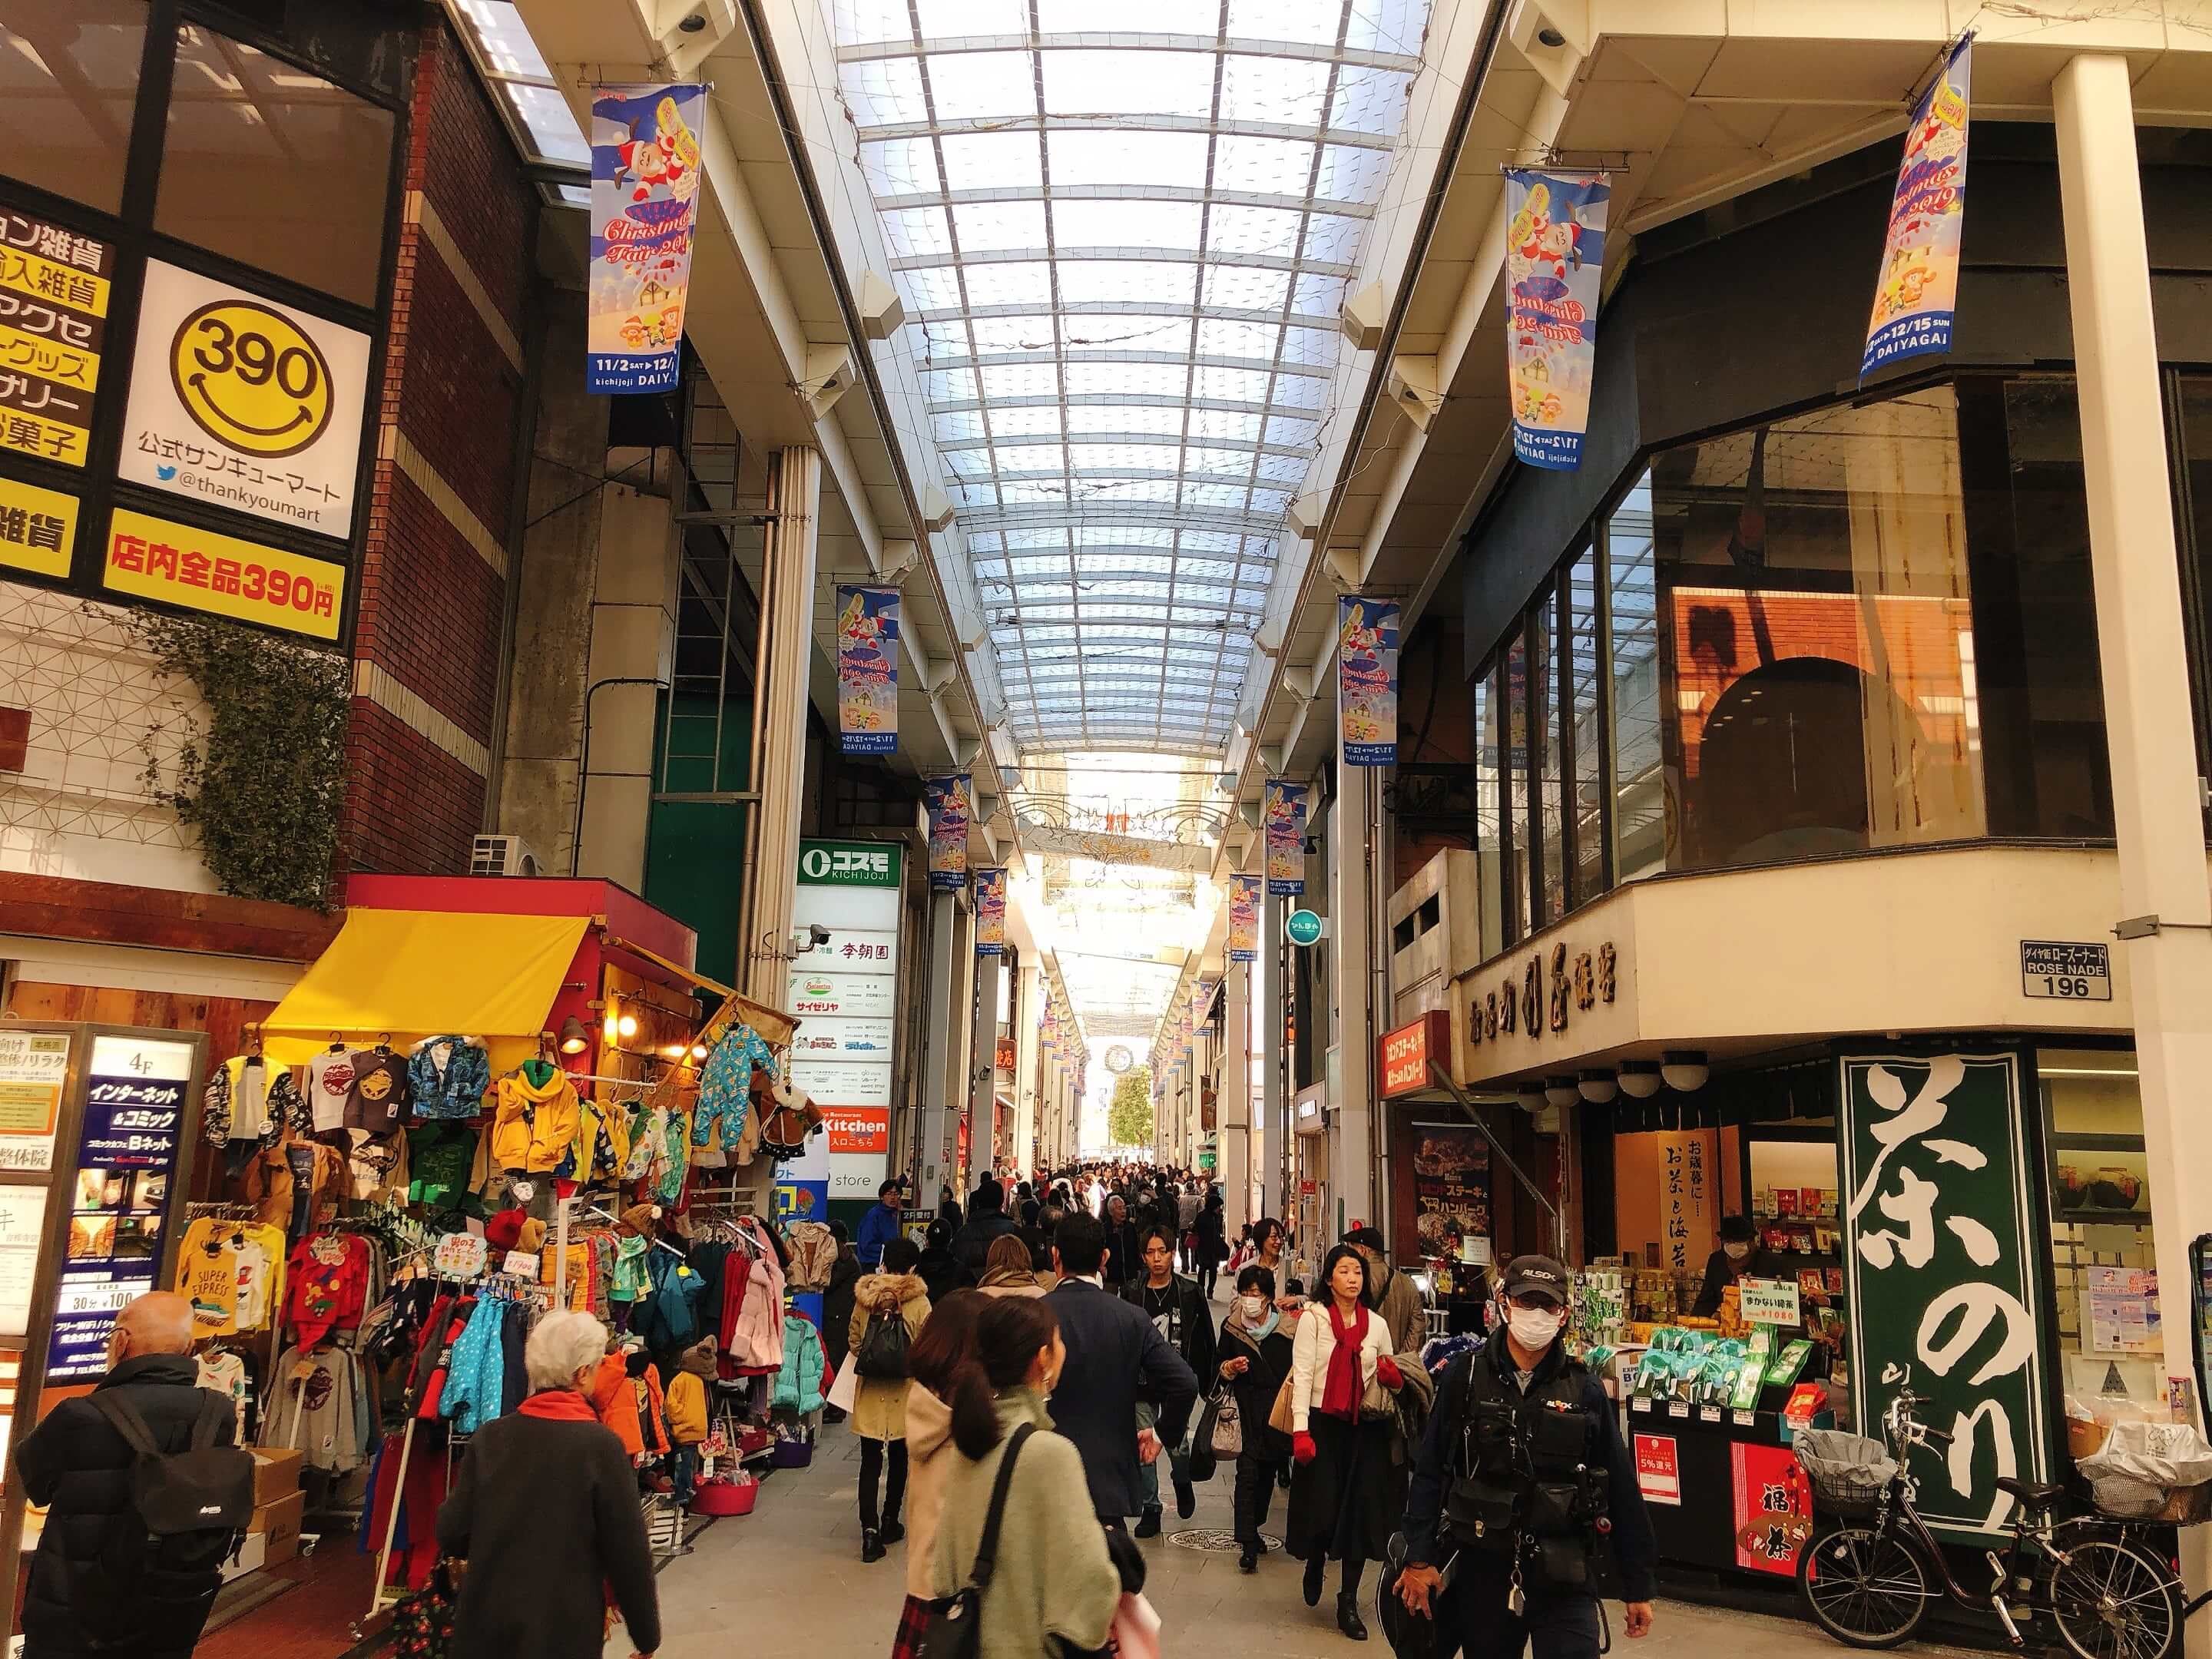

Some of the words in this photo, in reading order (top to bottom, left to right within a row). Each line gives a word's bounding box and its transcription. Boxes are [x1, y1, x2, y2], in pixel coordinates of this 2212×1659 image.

[1891, 316, 1932, 339] 12/15
[1877, 332, 1947, 359] DAIYAGAI
[194, 317, 318, 399] 390
[596, 359, 628, 372] 11/2
[595, 377, 633, 387] kichijoji
[138, 431, 341, 503] 公式サンキューマート
[179, 472, 321, 524] @thankyoumart
[112, 533, 334, 618] 店内全品390円
[833, 851, 889, 873] コスモ
[832, 871, 889, 880] KICHIJOJI
[839, 942, 889, 960] 李朝園
[2027, 962, 2064, 975] ROSE
[2068, 964, 2104, 976] NADE
[2043, 976, 2089, 997] 196
[796, 1002, 839, 1012] サイゼリヤ
[129, 1052, 153, 1075] 4F
[90, 1082, 179, 1104] インターネット
[112, 1110, 175, 1128] &コミック
[822, 1119, 886, 1132] Kitchen
[128, 1135, 173, 1151] Bネット
[830, 1137, 873, 1147] 入口こちら
[836, 1172, 871, 1187] store
[451, 1237, 476, 1248] 男の子
[198, 1270, 228, 1283] SUPER
[1522, 1269, 1557, 1282] ALSOK
[192, 1284, 230, 1297] EXPRESS
[73, 1296, 98, 1310] 30分
[1747, 1296, 1794, 1310] まかない緑茶
[1762, 1310, 1793, 1320] ¥1080
[1641, 1459, 1673, 1471] 5%還元
